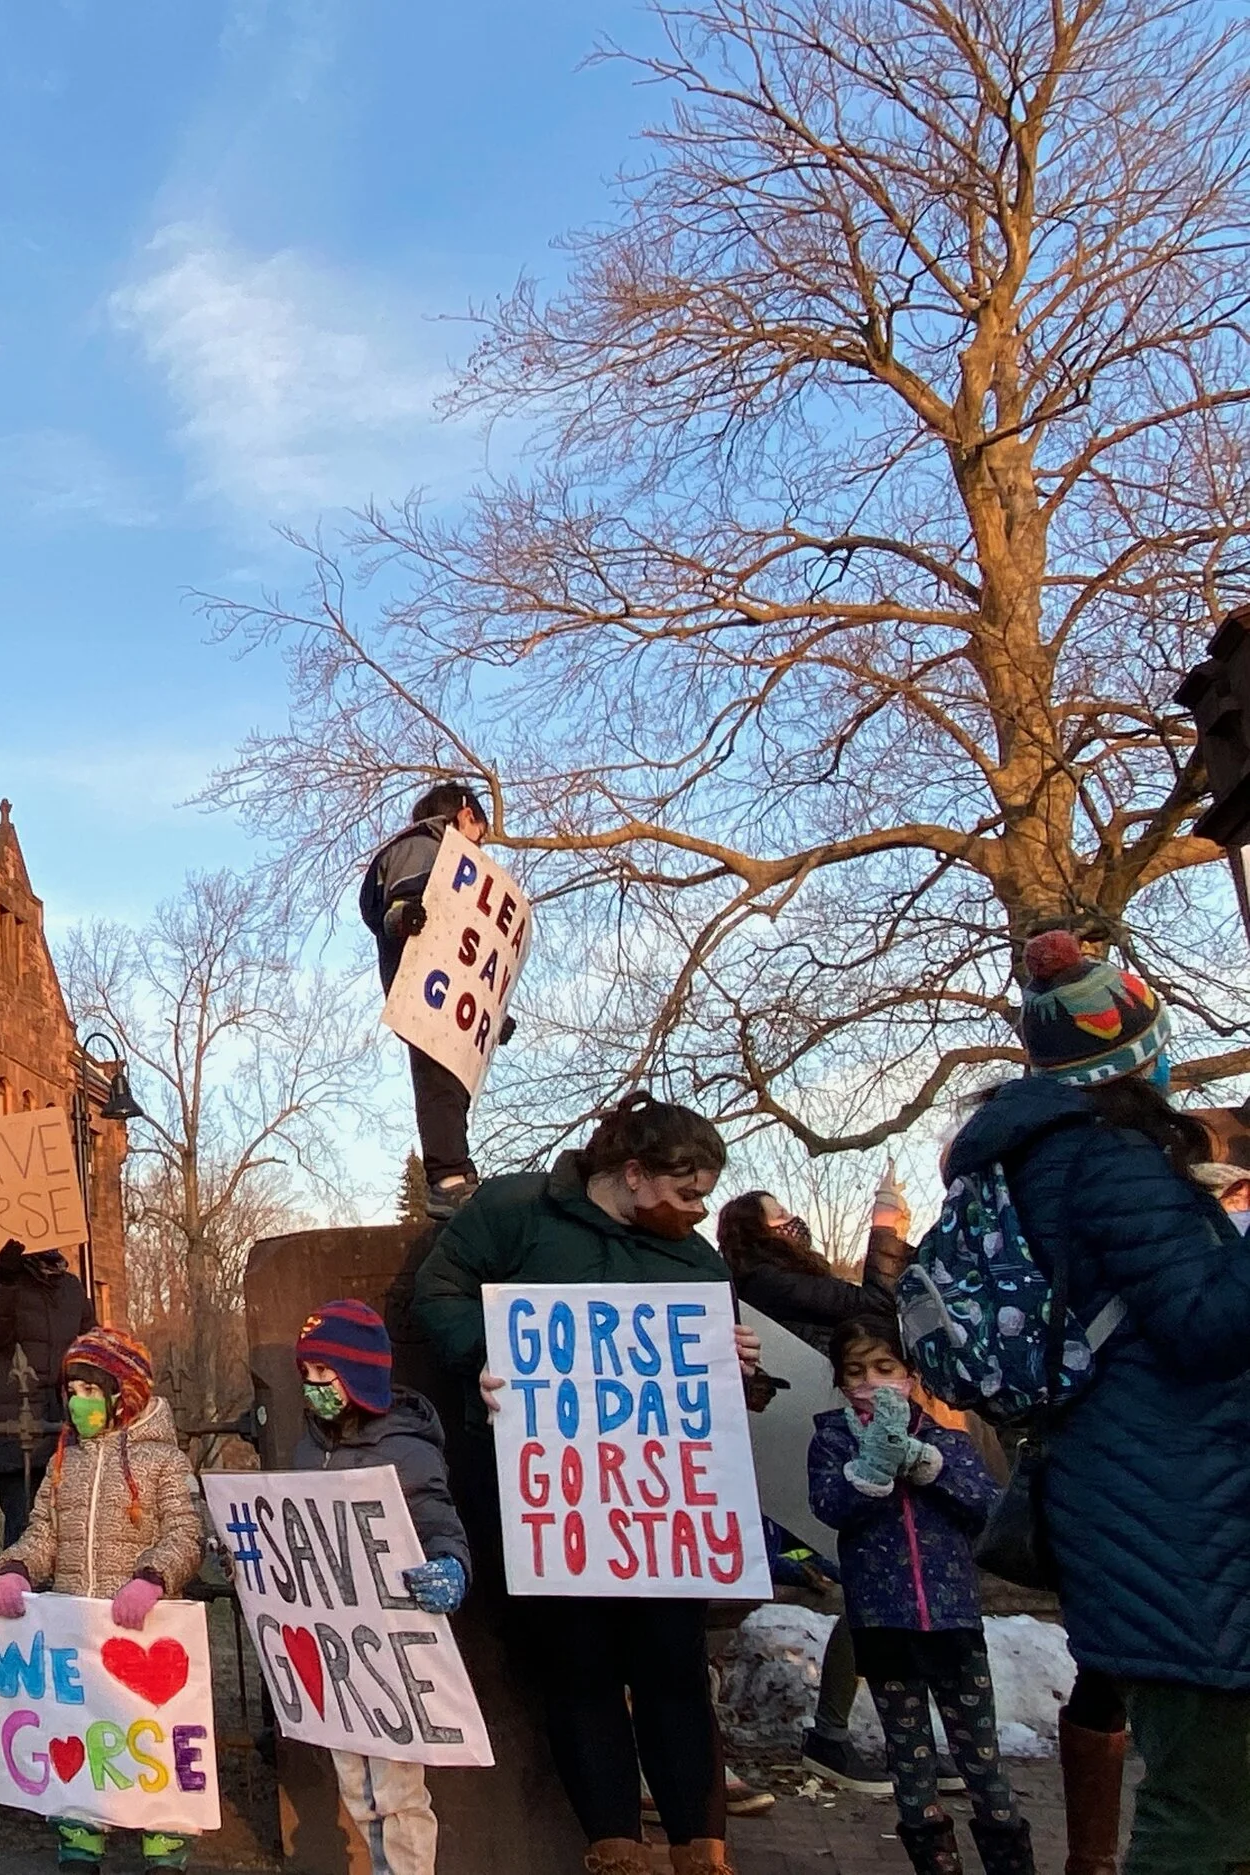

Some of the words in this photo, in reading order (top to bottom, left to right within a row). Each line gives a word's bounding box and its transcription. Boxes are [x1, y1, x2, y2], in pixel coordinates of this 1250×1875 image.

[452, 854, 526, 959] PLEA
[458, 927, 511, 1005] SAV
[424, 969, 491, 1055] GOR
[508, 1298, 709, 1377] GORSE
[519, 1440, 718, 1507] GORSE
[226, 1496, 418, 1610] #SAVE
[521, 1510, 587, 1578] TO
[608, 1508, 744, 1584] STAY
